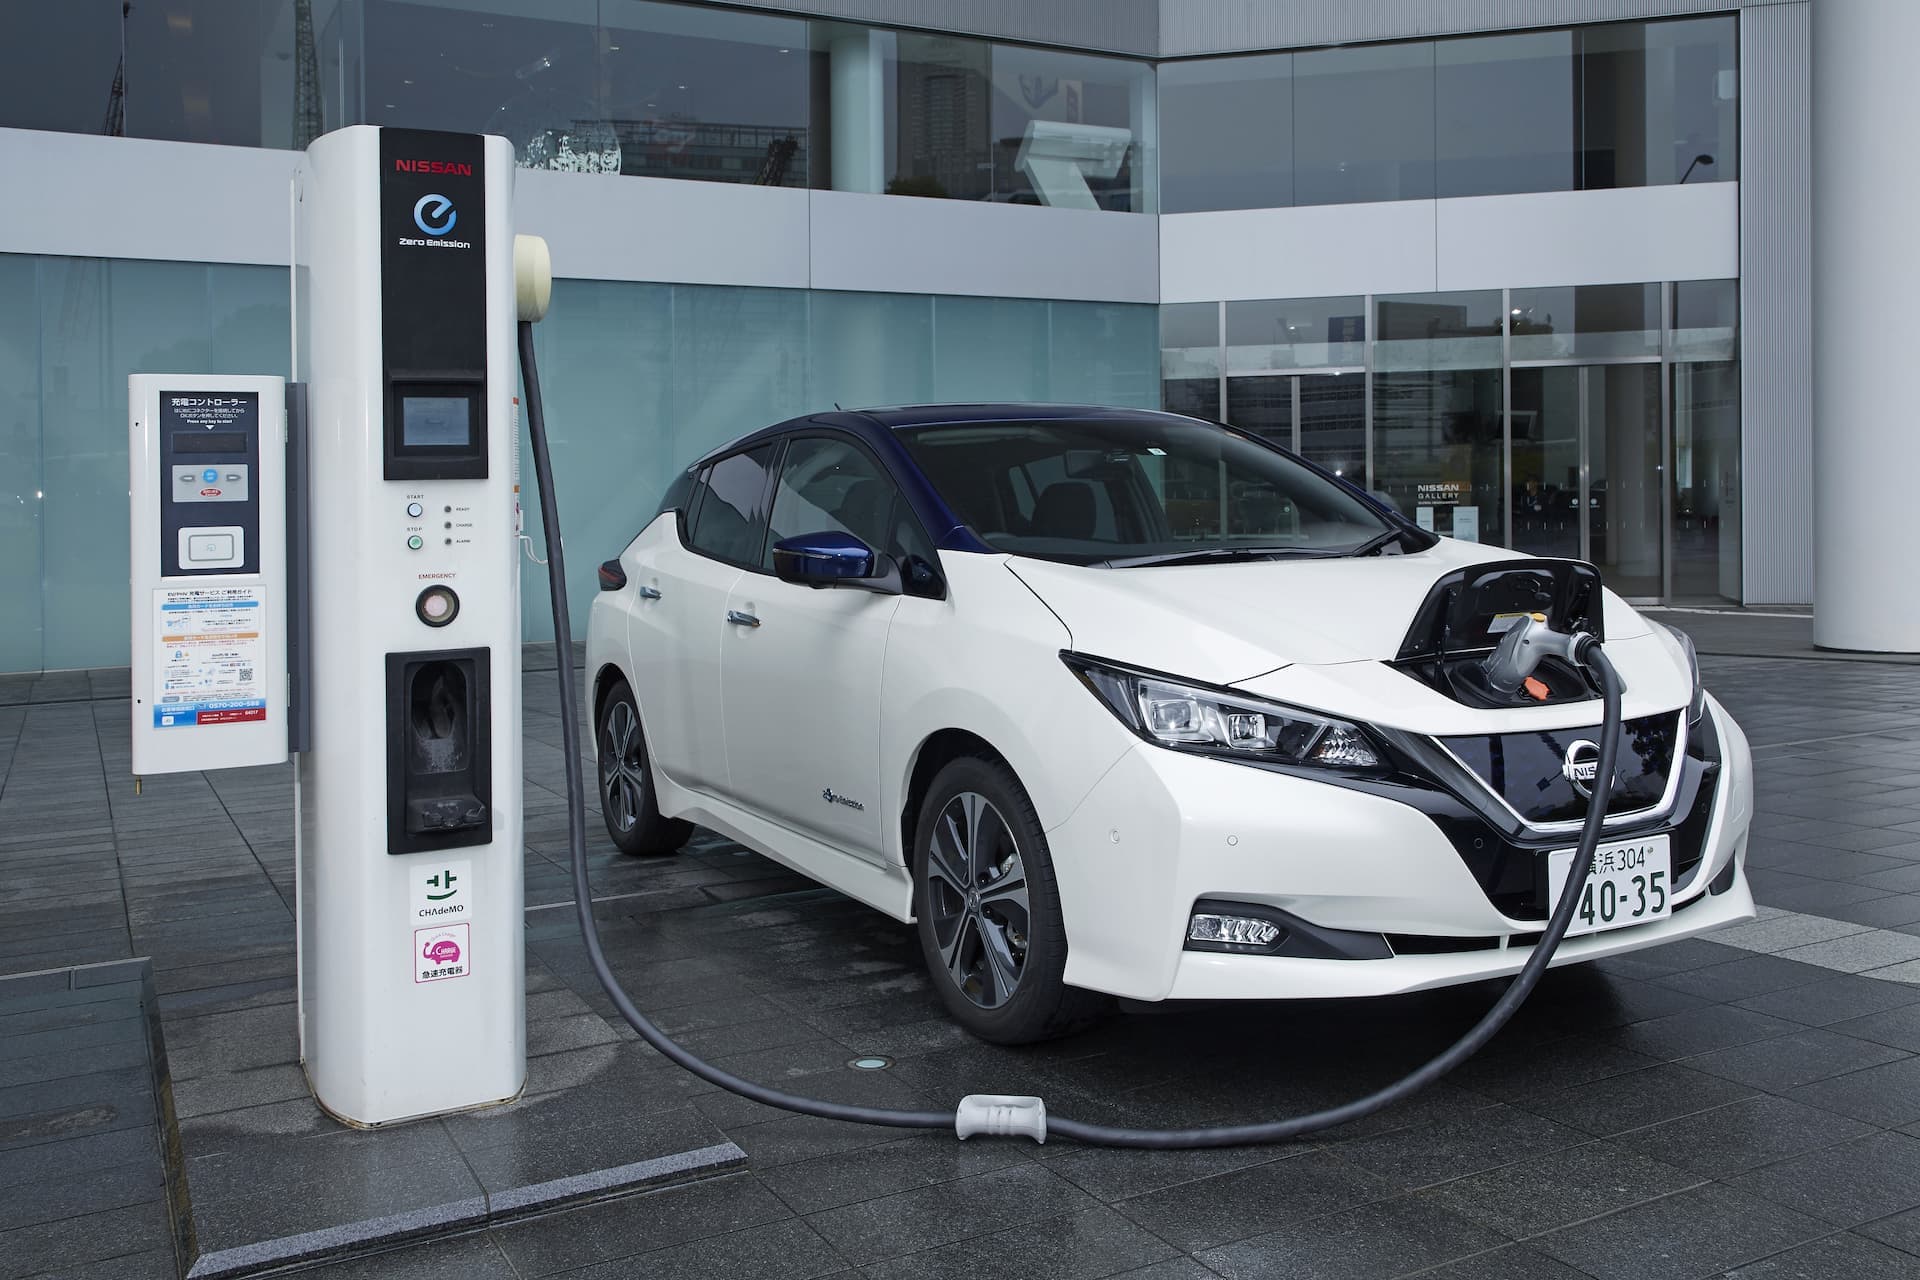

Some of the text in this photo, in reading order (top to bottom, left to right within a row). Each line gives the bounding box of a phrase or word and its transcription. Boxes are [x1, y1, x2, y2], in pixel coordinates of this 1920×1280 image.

[395, 159, 472, 177] NISSAN
[399, 237, 471, 249] Zero Emission
[171, 398, 248, 406] 充電コントローラー
[1417, 484, 1460, 492] NISSAN
[1574, 765, 1596, 777] NIS
[1617, 846, 1645, 871] 304
[1579, 871, 1665, 926] 40-35
[418, 904, 464, 917] CHAdeMO
[422, 966, 463, 979] 急速充電器
